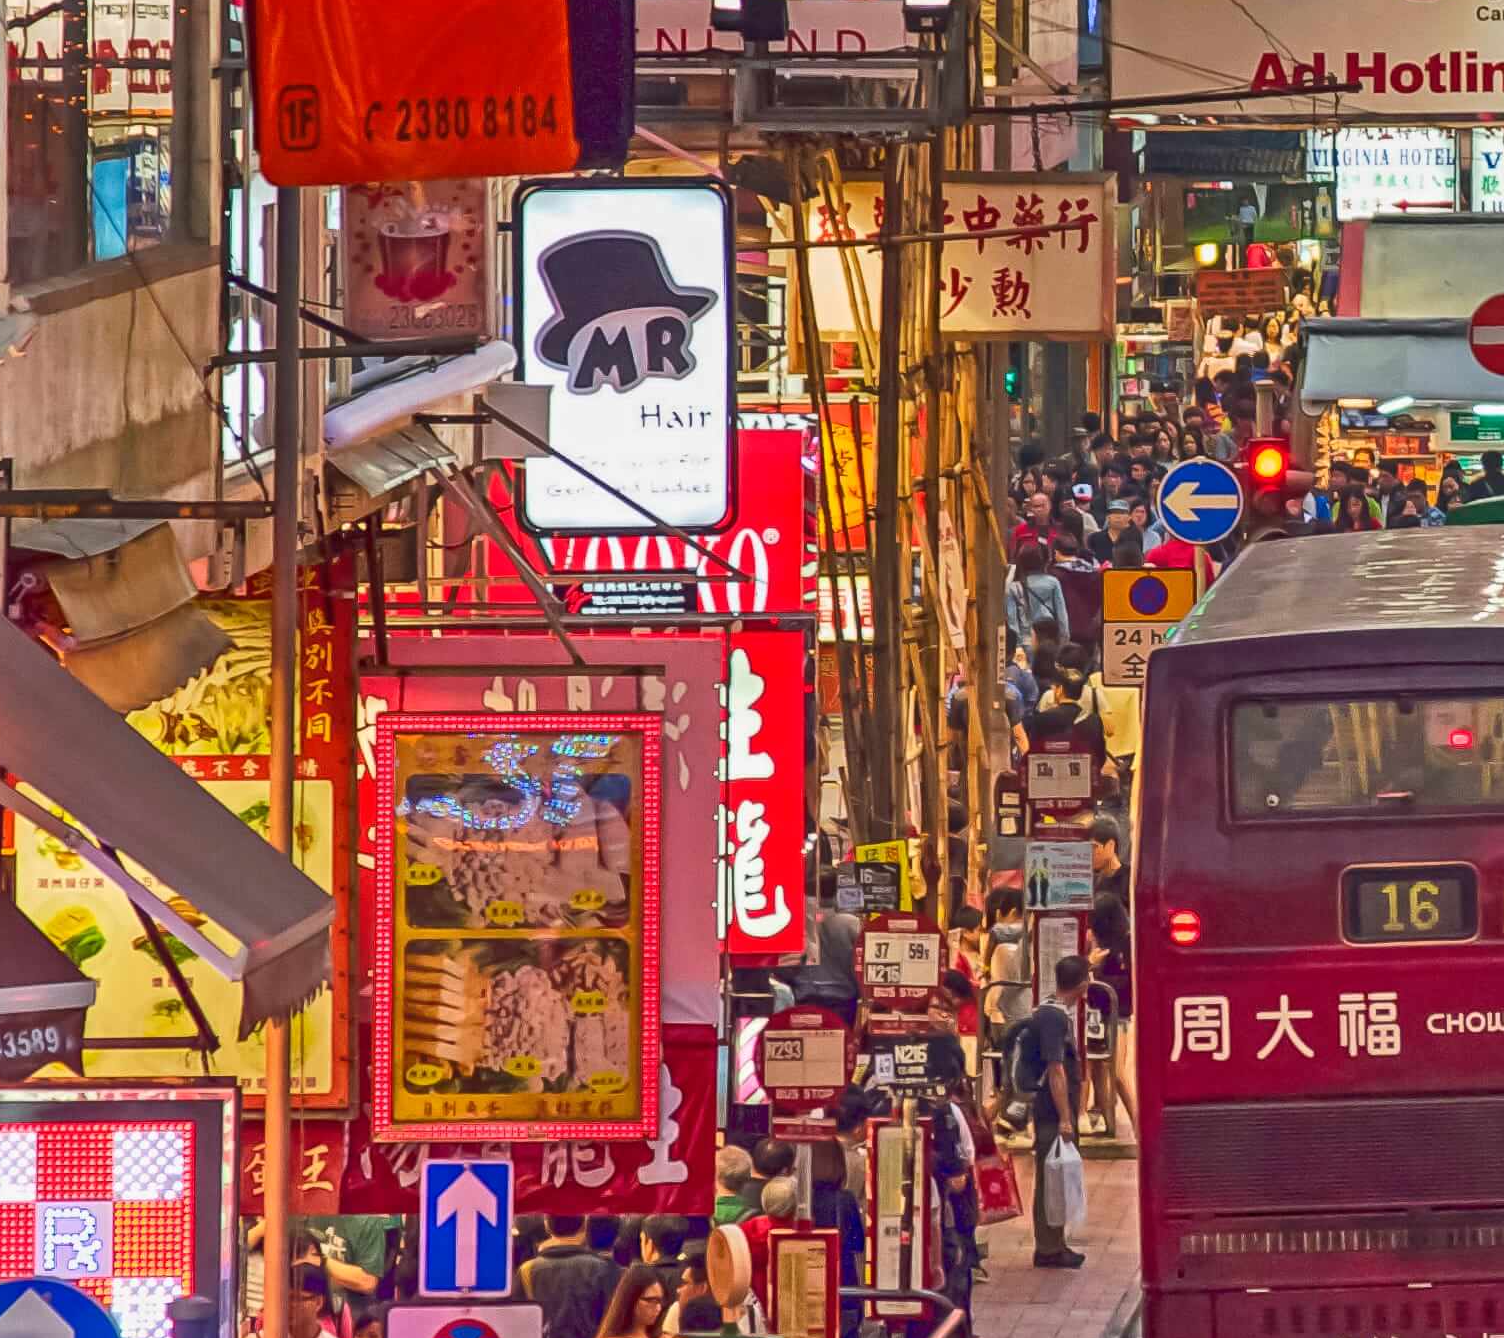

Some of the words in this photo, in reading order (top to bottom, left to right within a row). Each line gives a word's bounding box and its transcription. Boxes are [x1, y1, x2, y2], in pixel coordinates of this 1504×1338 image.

[395, 100, 470, 143] 2380
[483, 94, 559, 139] 8184
[571, 316, 696, 390] MR
[639, 403, 714, 431] Hair
[1113, 629, 1142, 647] 24
[1380, 880, 1441, 932] 16
[1170, 990, 1402, 1062] 周大福
